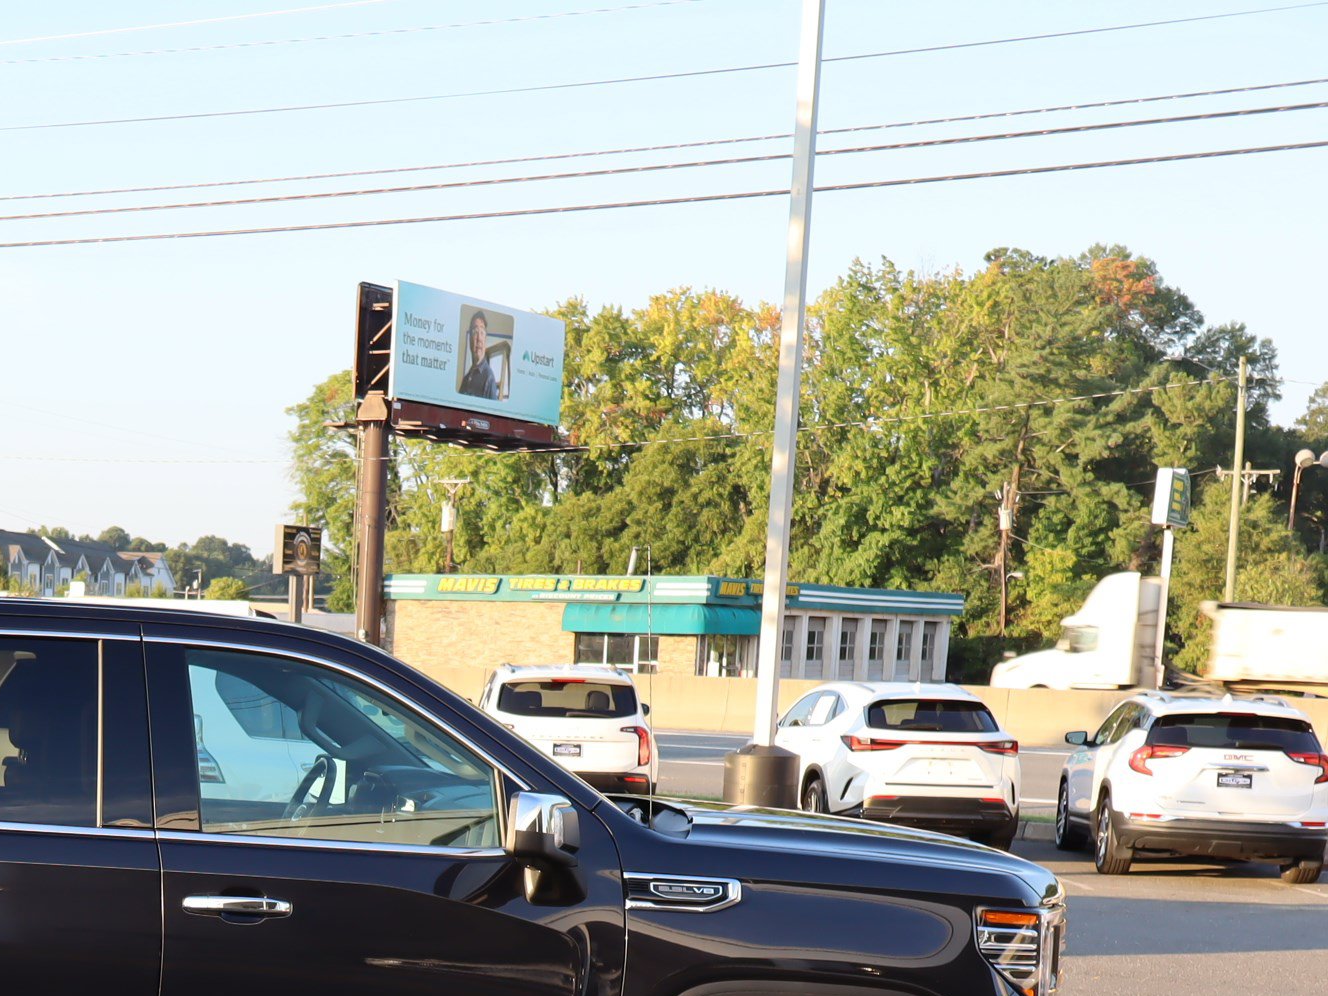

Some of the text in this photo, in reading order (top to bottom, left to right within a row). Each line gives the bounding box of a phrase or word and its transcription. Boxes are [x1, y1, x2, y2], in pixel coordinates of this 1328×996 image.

[404, 311, 445, 333] Money for
[403, 331, 453, 353] the moments
[402, 348, 419, 366] that
[530, 351, 554, 368] Upstart
[437, 577, 641, 593] MAVIS TIRES & BRAKES
[719, 582, 746, 596] MAVIS
